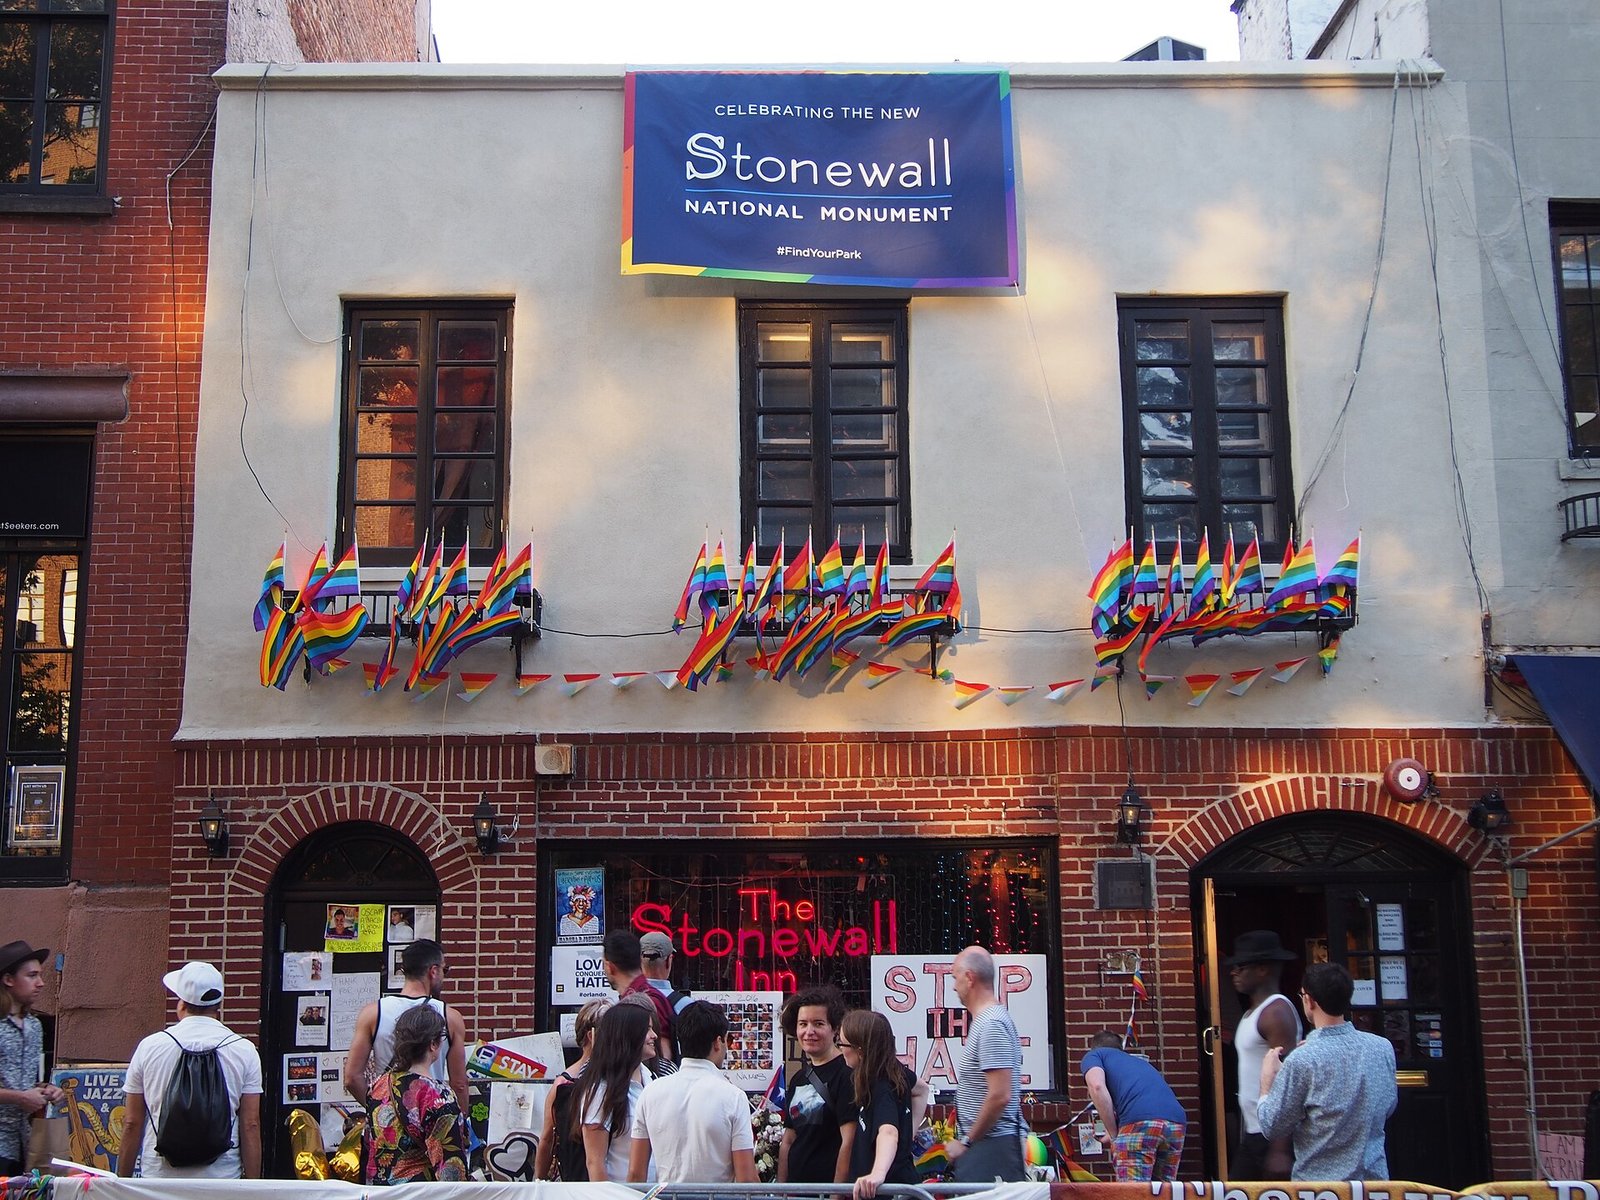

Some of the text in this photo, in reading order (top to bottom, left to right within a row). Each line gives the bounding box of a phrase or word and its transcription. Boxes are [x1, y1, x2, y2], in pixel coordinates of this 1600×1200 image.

[714, 104, 921, 120] CELEBRATING THE NEW
[685, 132, 953, 189] Stonewall
[685, 199, 953, 222] NATIONAL MONUMENT
[776, 246, 863, 260] #FindYourPark
[0, 522, 60, 530] tSeekers.com
[738, 888, 815, 921] The
[631, 899, 897, 957] Stonewall
[735, 960, 797, 993] Inn
[884, 962, 1033, 1013] STP
[928, 1008, 971, 1038] TH
[498, 1055, 540, 1079] STAY
[84, 1075, 119, 1087] LIVE
[83, 1087, 124, 1100] JAZZ
[100, 1103, 110, 1113] &
[1558, 1135, 1576, 1156] AM
